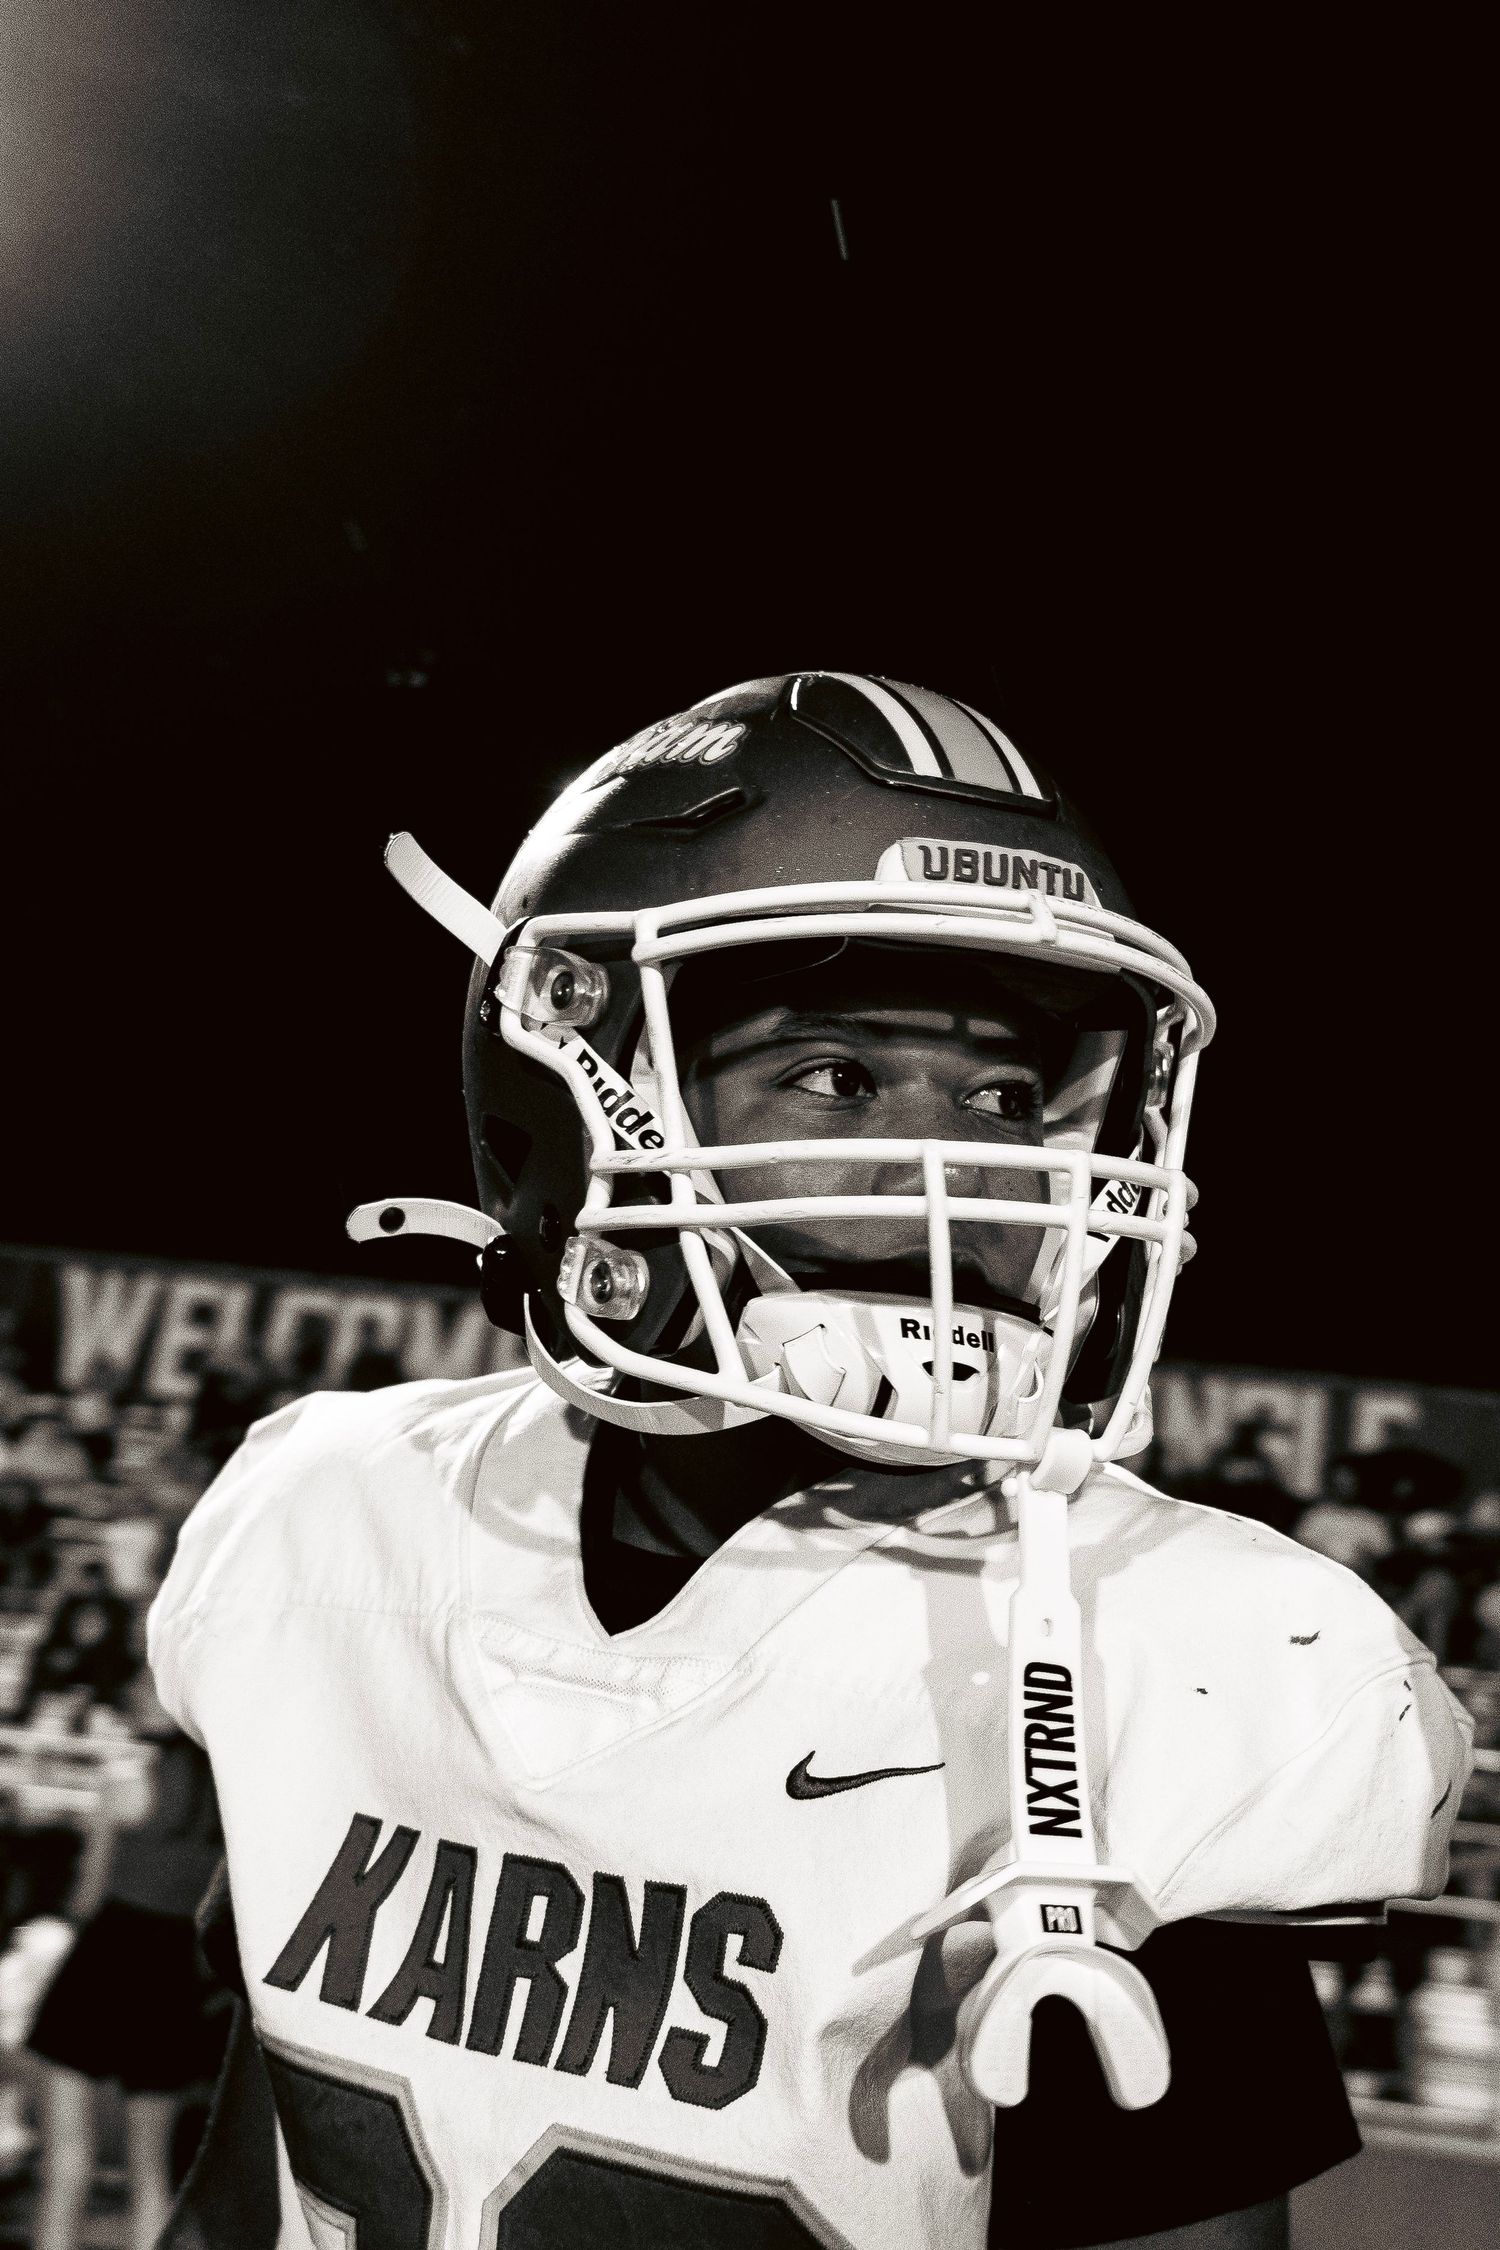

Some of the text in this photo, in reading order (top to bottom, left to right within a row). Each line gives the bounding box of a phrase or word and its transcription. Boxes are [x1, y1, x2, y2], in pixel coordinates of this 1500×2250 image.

[917, 844, 1085, 901] UBUNTU
[576, 1048, 665, 1151] Ridde
[899, 1317, 995, 1353] Ridell
[1023, 1661, 1083, 1839] NXTRND
[262, 1812, 784, 2111] KARNS
